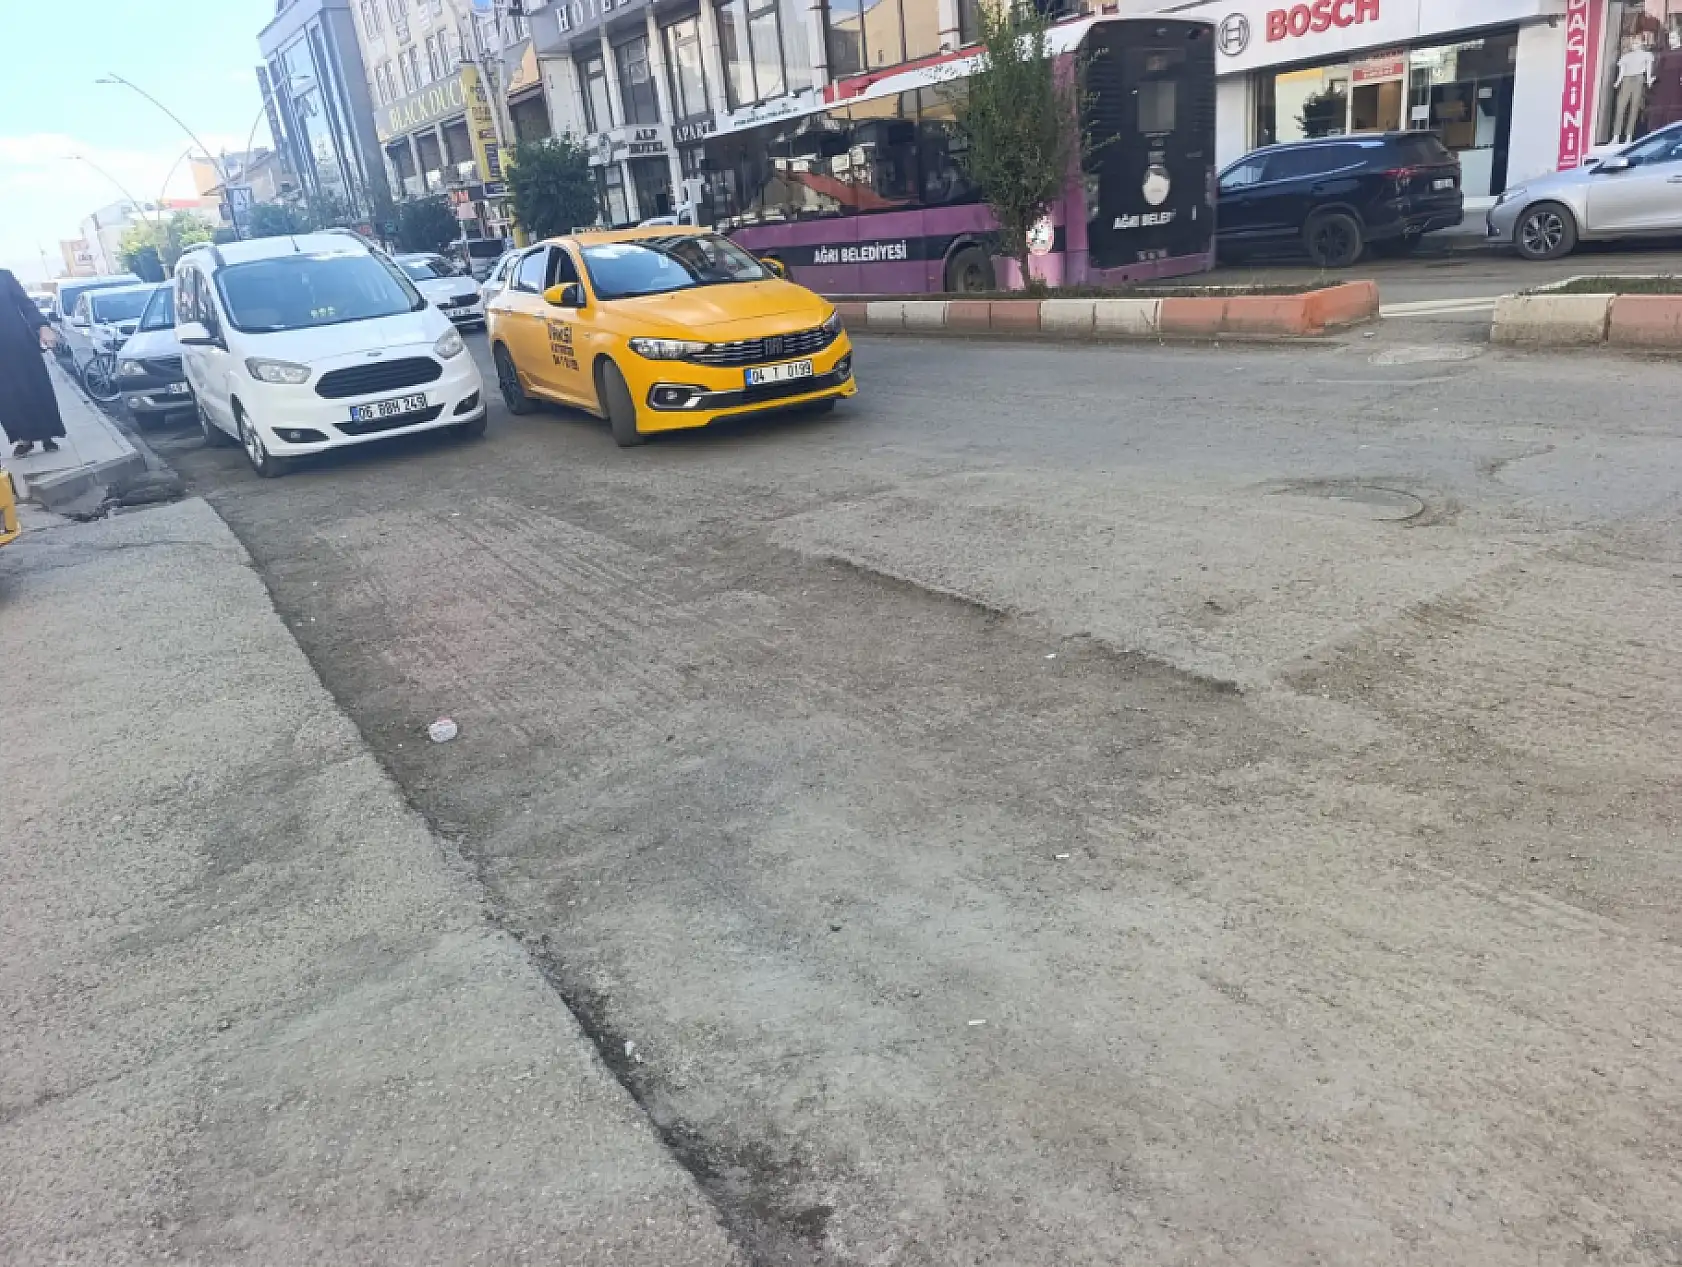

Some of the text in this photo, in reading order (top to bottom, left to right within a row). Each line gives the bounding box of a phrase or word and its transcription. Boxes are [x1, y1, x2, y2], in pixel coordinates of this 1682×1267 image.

[556, 0, 629, 32] HOTE
[1266, 0, 1380, 42] BOSCH
[389, 94, 429, 130] BLACK
[814, 240, 907, 264] AĞRI BELEDİYESİ
[753, 369, 765, 382] 04
[788, 361, 811, 377] 0199
[360, 405, 373, 420] 06
